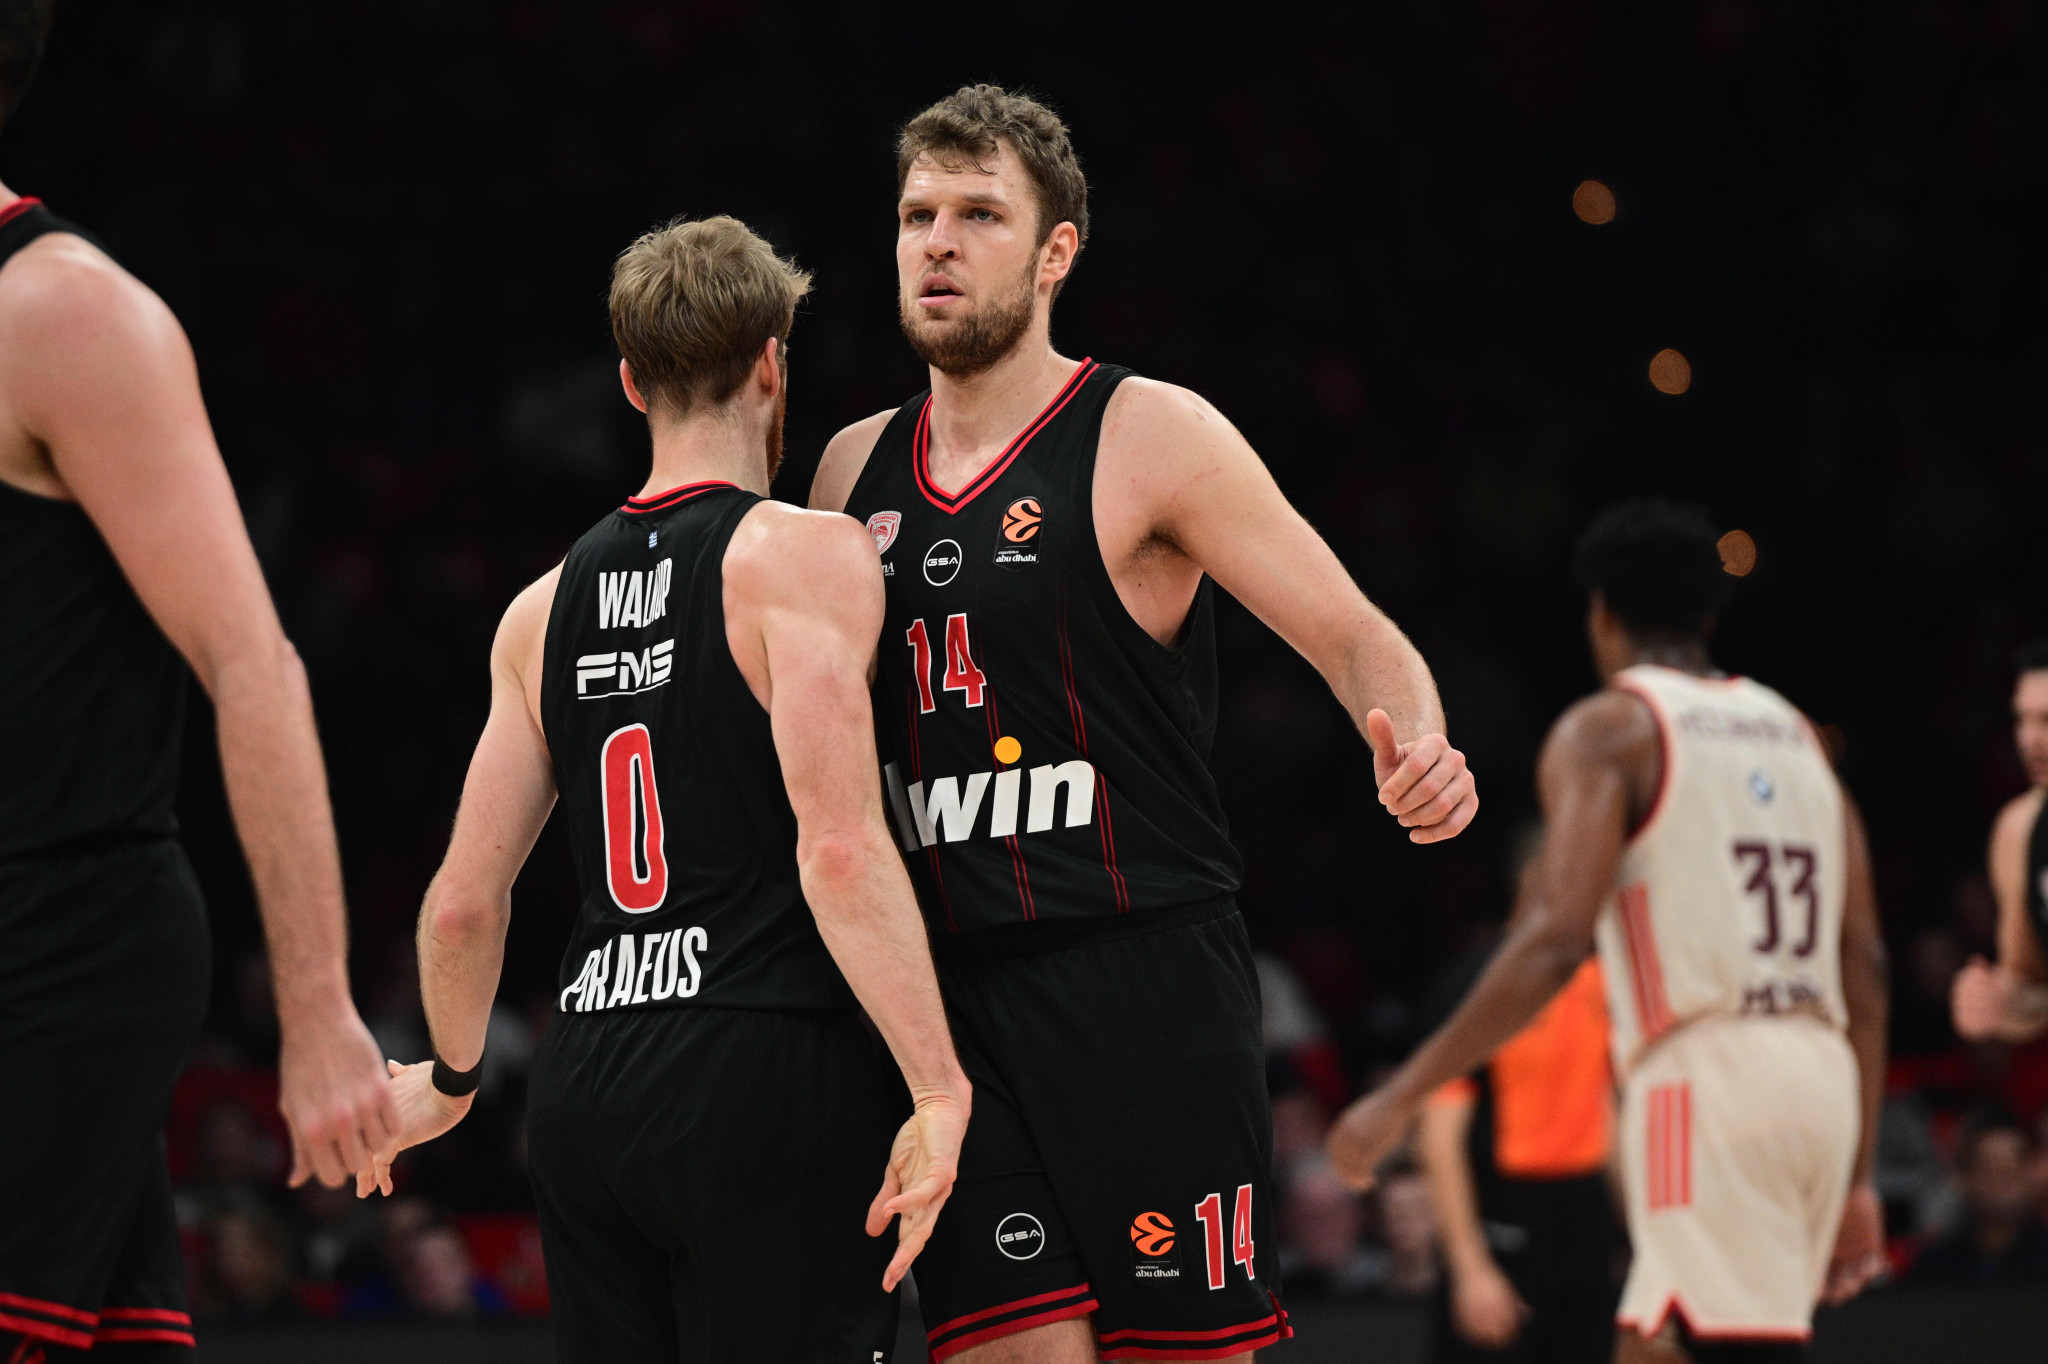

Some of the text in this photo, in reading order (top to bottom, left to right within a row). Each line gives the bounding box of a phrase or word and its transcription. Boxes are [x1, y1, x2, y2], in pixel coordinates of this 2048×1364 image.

[996, 554, 1037, 563] abu dhabi
[577, 639, 675, 695] FMS
[906, 613, 987, 714] 14
[600, 722, 668, 914] 0
[884, 736, 1095, 852] win
[1733, 842, 1817, 958] 33
[1135, 1268, 1180, 1278] abu dhabi
[1195, 1183, 1255, 1290] 14
